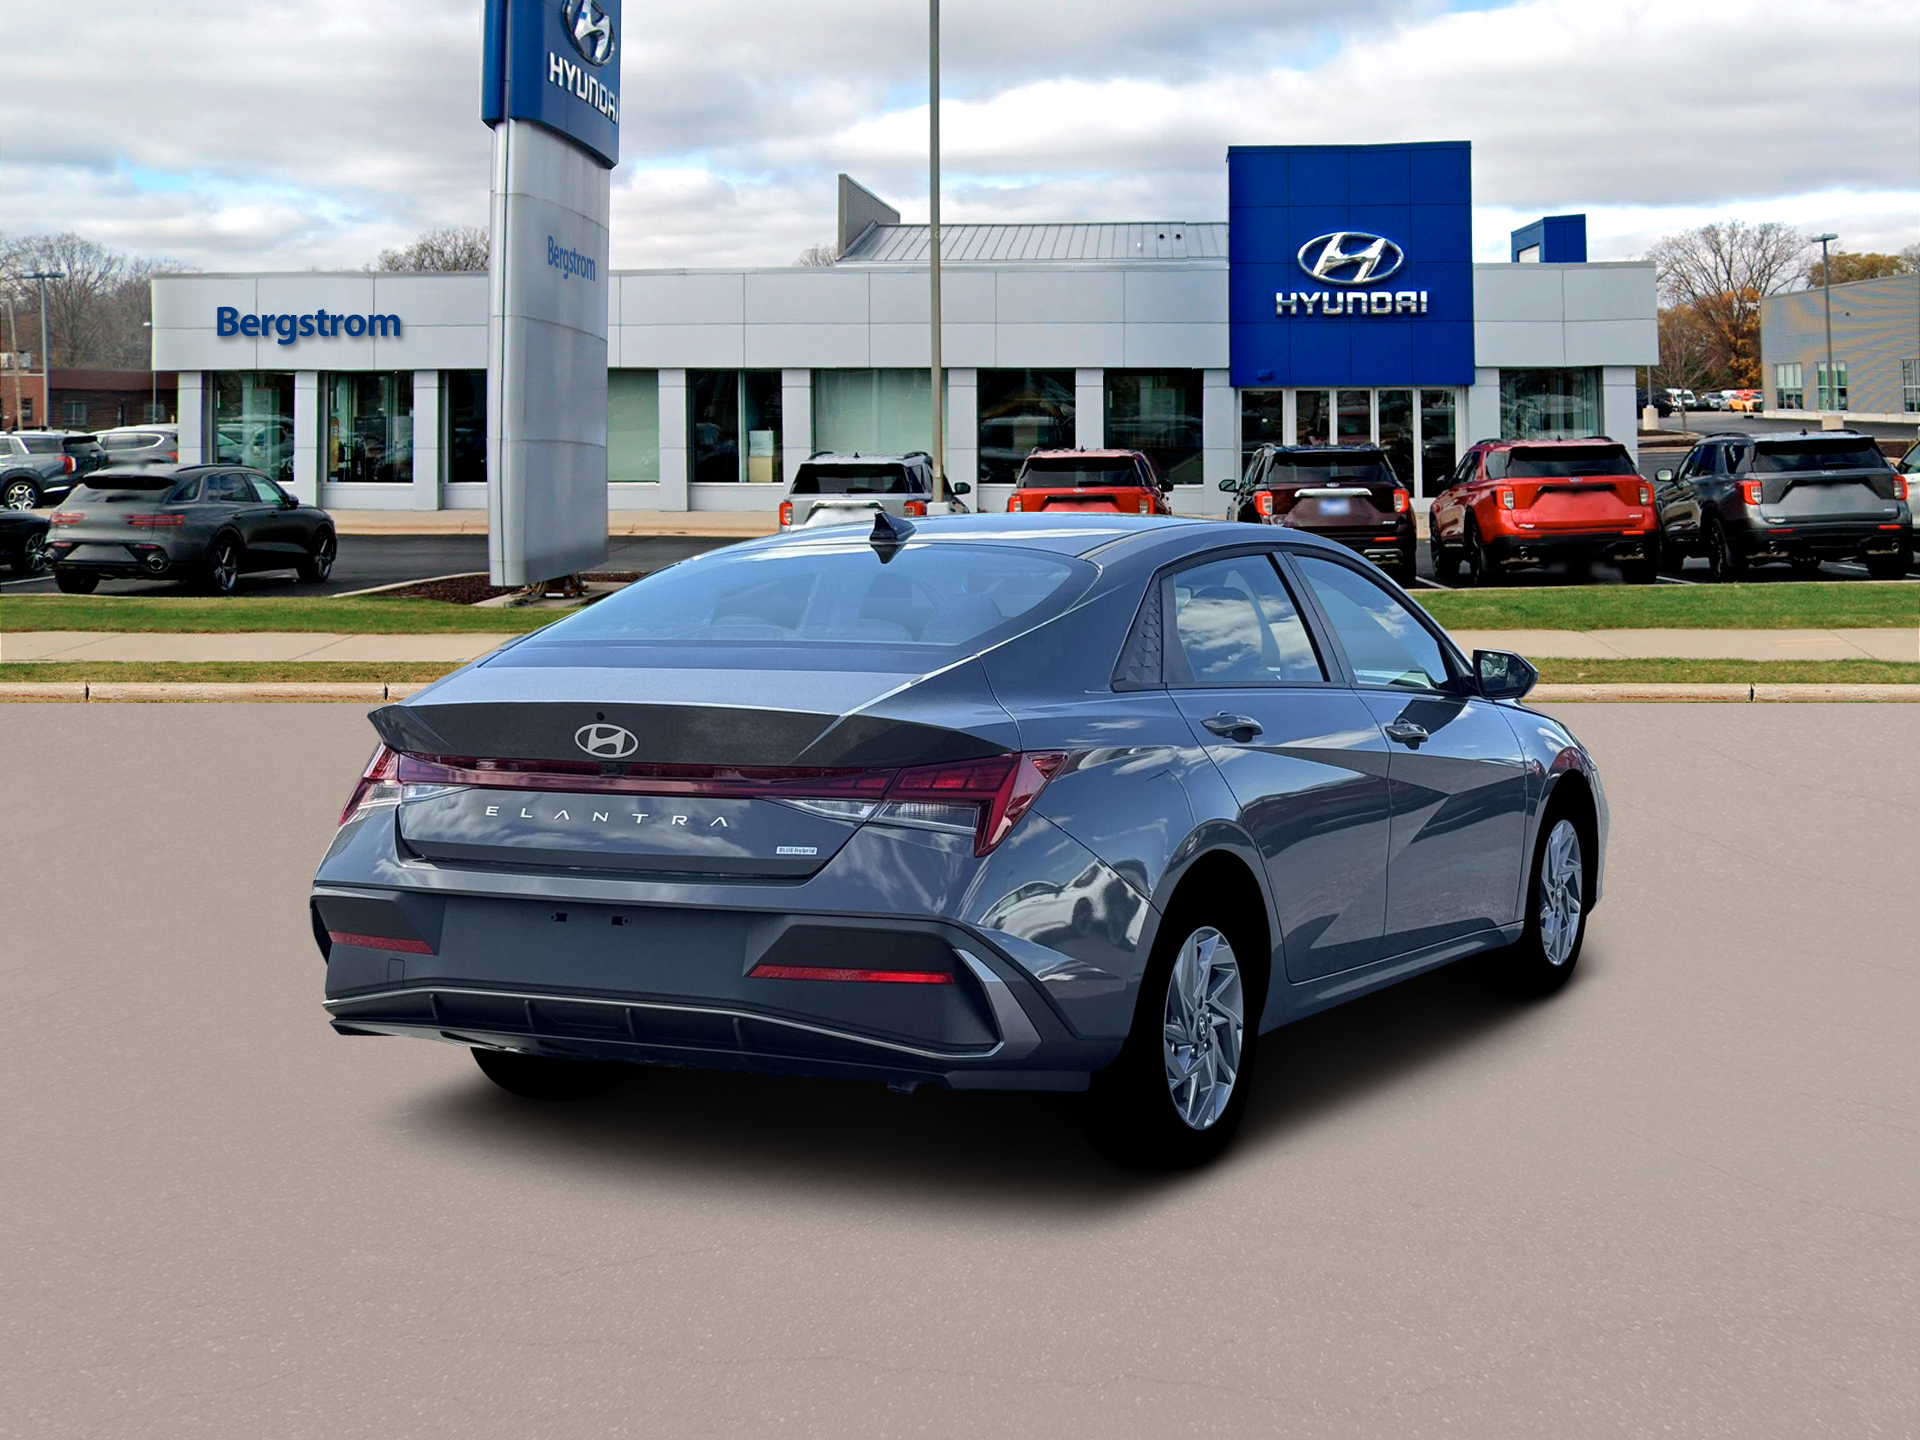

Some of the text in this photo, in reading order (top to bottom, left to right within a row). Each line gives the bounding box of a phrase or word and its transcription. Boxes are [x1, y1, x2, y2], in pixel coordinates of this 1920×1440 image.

[548, 52, 619, 124] HYUNDAI
[547, 235, 596, 282] Bergstrom
[1275, 290, 1428, 315] HYUNDAI
[216, 306, 401, 345] Bergstrom
